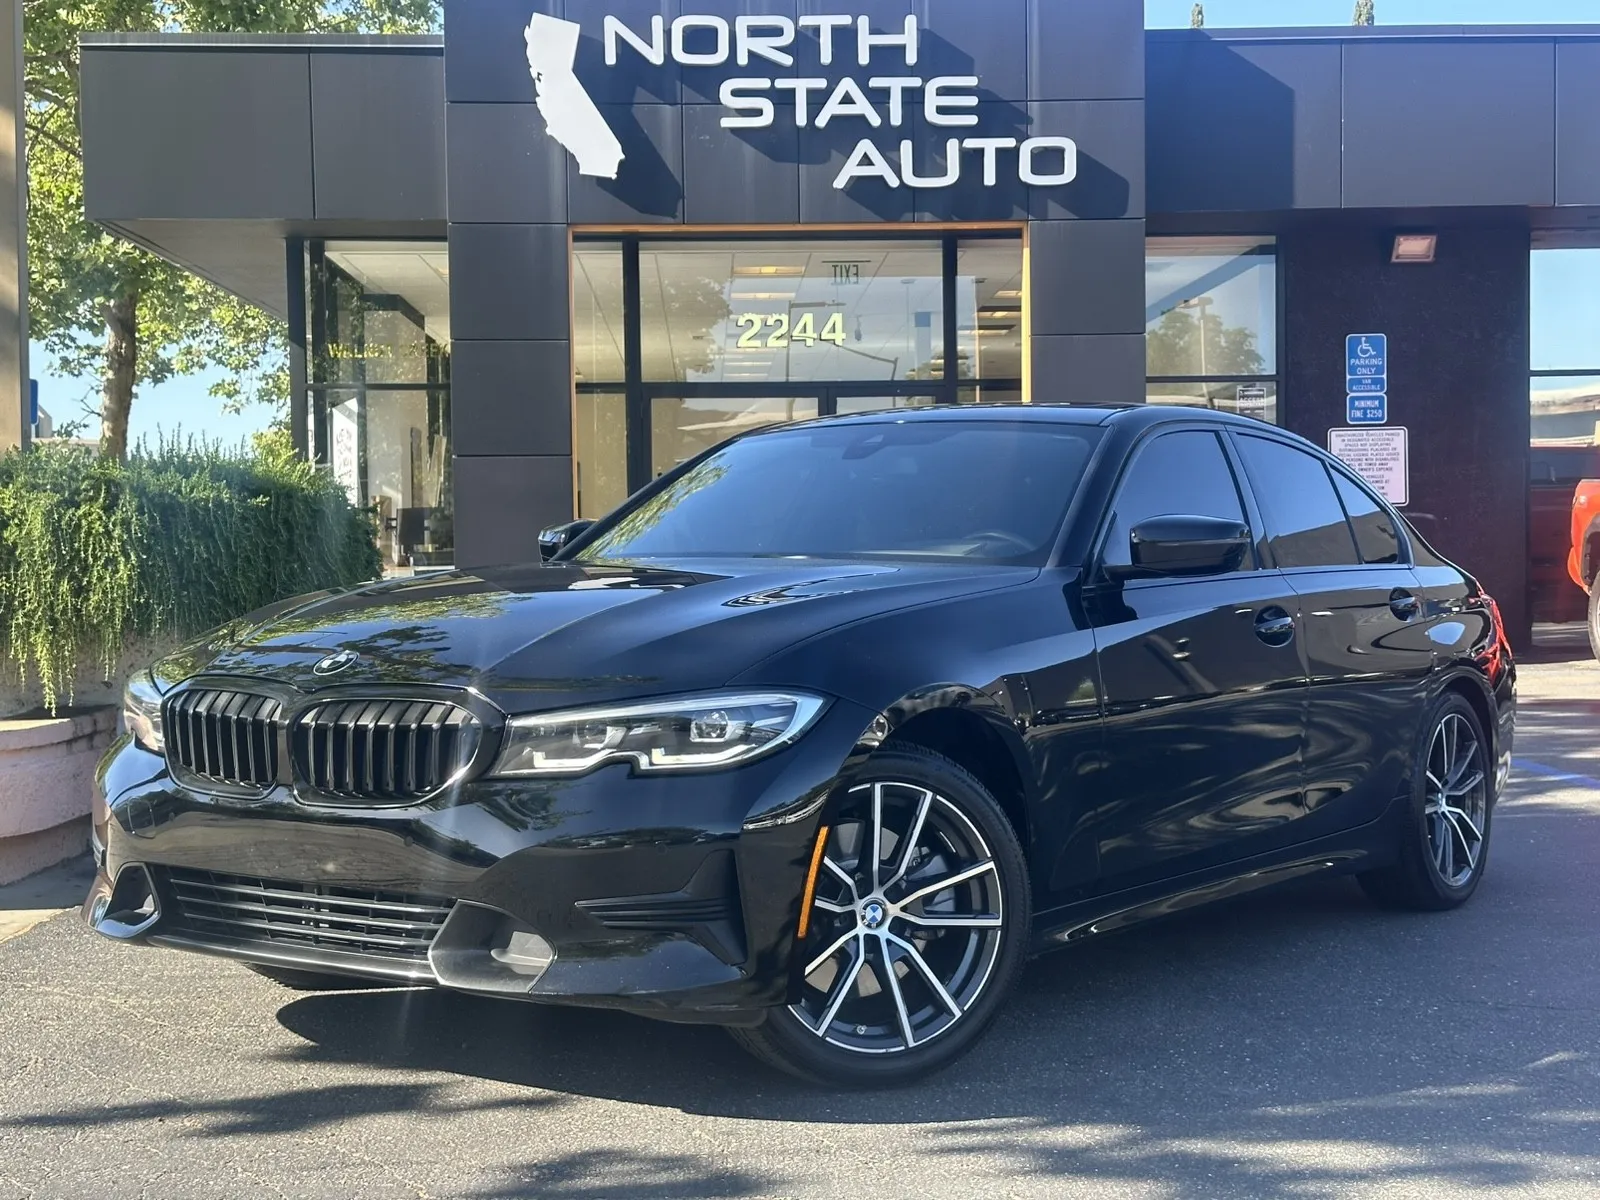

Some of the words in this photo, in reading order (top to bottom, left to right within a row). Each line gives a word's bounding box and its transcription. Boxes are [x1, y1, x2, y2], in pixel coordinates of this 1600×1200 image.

[603, 14, 918, 67] NORTH
[718, 76, 980, 129] STATE
[831, 136, 1078, 191] AUTO
[736, 312, 847, 349] 2244
[1350, 358, 1383, 366] PARKING
[1356, 367, 1376, 375] ONLY
[1351, 410, 1364, 418] FINE
[1366, 409, 1382, 418] $250
[1354, 399, 1379, 407] MINIMUM
